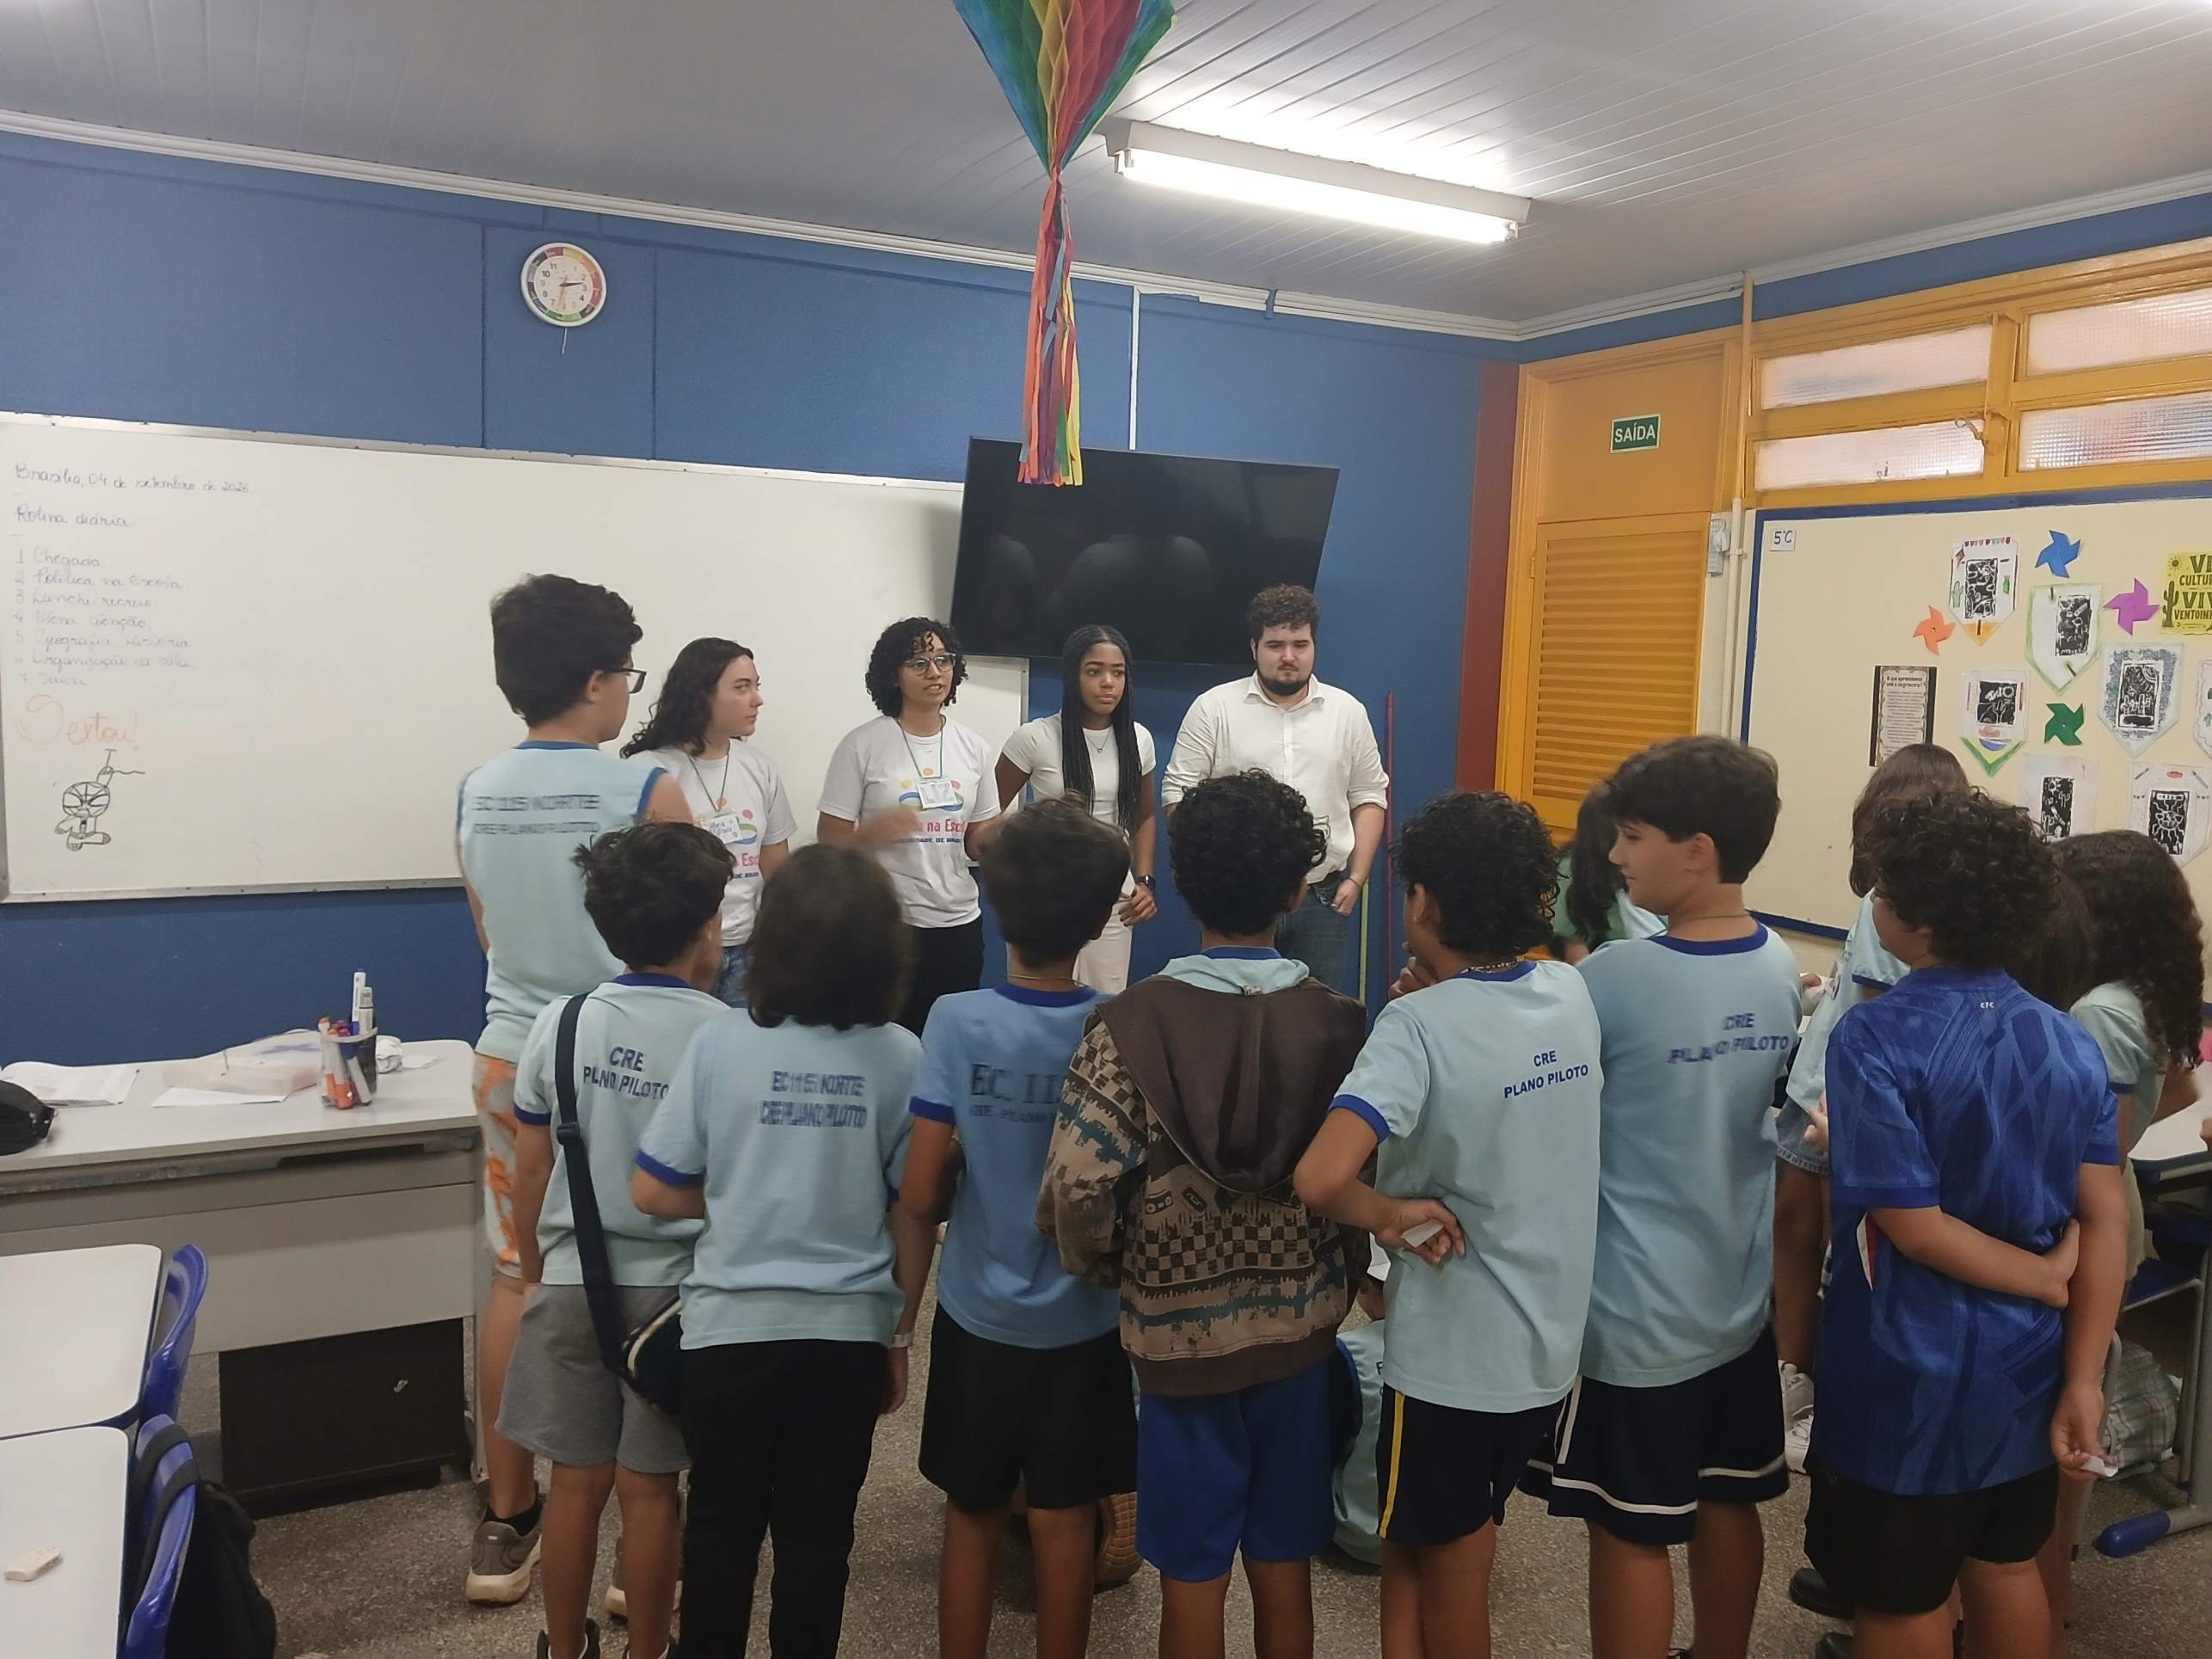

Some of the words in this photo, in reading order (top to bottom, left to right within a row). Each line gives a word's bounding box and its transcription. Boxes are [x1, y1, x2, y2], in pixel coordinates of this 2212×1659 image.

[1614, 422, 1656, 443] SAÍDA
[89, 472, 107, 486] 04
[114, 476, 127, 488] de
[135, 475, 195, 490] setembro
[15, 503, 68, 523] Rotina
[76, 512, 130, 527] diária
[927, 822, 941, 833] na
[1720, 1013, 1755, 1030] CRE
[609, 1046, 644, 1072] CRE
[1533, 1050, 1557, 1067] CRE
[1504, 1076, 1544, 1099] PLANO
[1548, 1064, 1588, 1085] PILOTO
